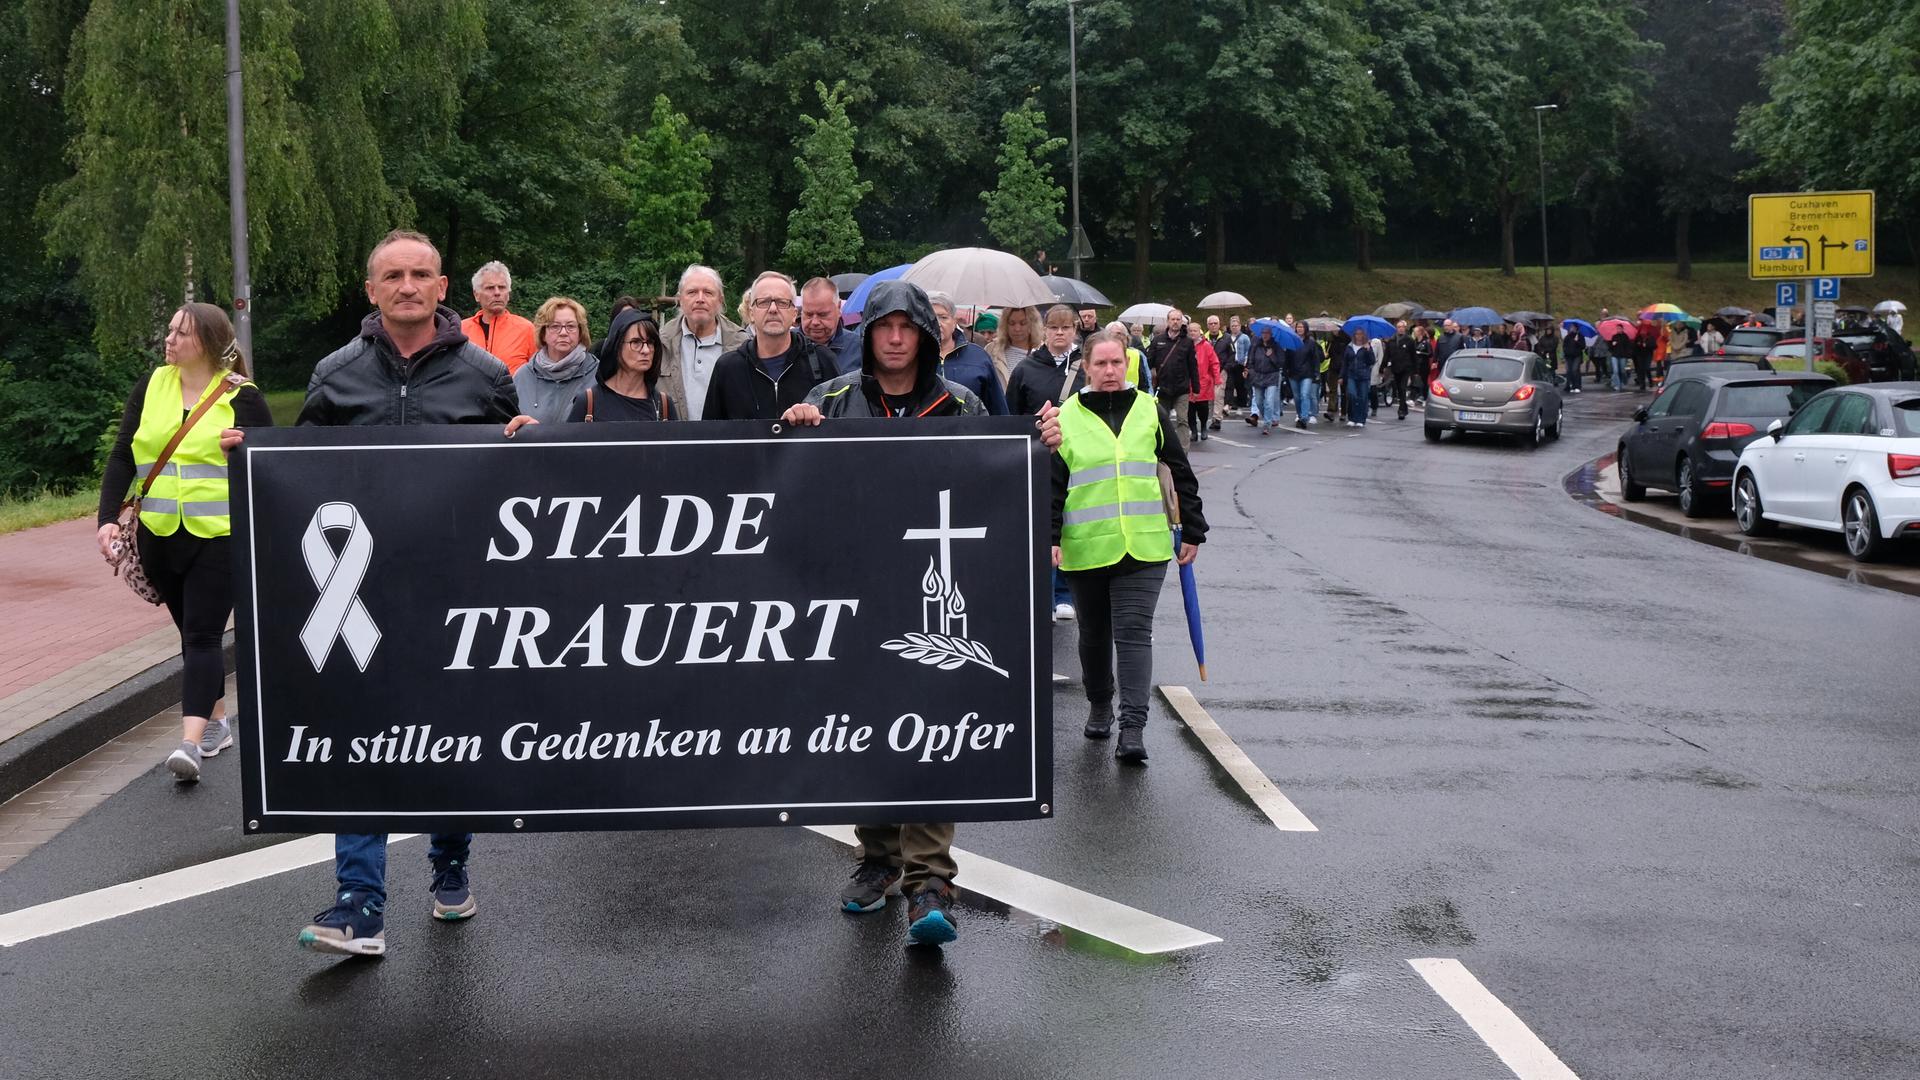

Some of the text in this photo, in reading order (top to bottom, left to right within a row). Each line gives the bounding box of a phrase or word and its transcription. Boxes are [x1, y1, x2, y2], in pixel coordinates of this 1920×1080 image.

[1790, 200, 1838, 209] Cuxhaven
[1790, 211, 1857, 220] Bremerhaven
[1790, 223, 1820, 231] Zeven
[1759, 264, 1805, 273] Hamburg
[1781, 285, 1792, 304] P
[1818, 278, 1833, 297] P
[486, 492, 776, 562] STADE
[443, 599, 860, 670] TRAUERT
[282, 711, 1015, 764] In stillen Gedenken an die Opfer
